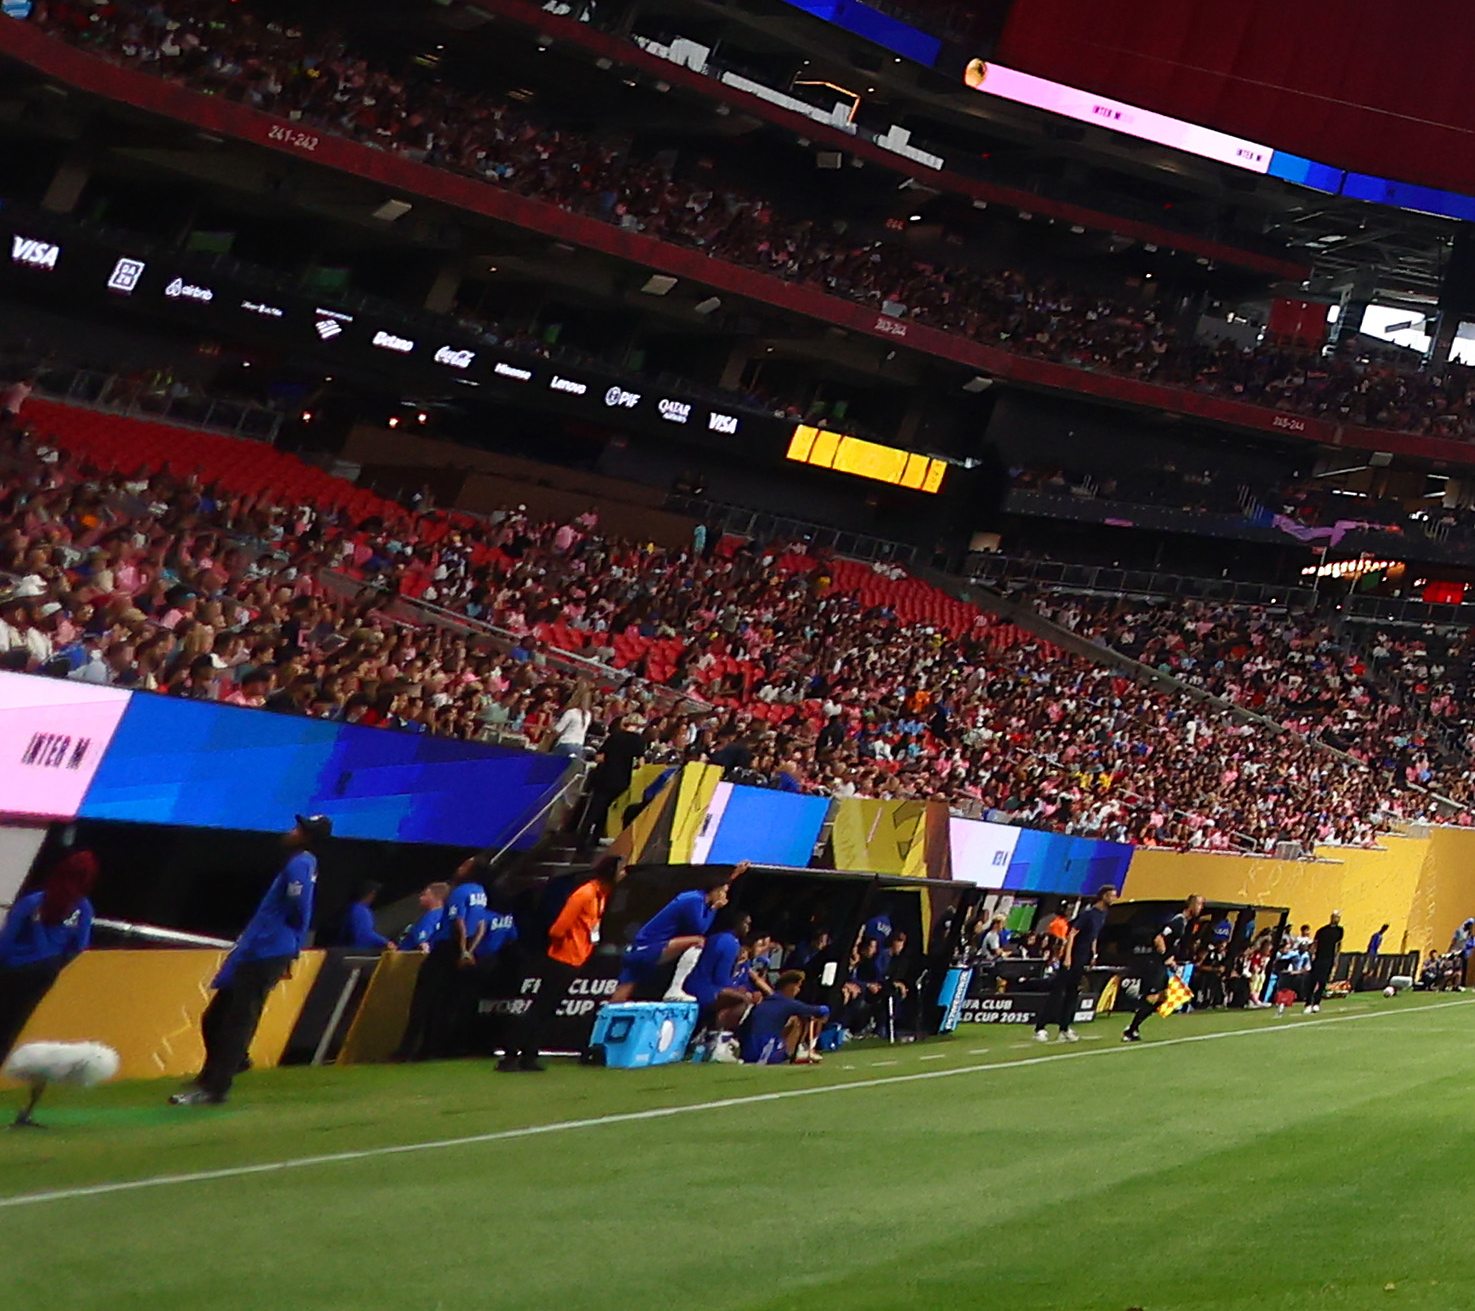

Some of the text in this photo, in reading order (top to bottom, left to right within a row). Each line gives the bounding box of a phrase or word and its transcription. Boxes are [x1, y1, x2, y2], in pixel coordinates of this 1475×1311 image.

[12, 235, 59, 268] VISA
[550, 375, 587, 394] Lenovo
[617, 391, 641, 408] PIF
[658, 399, 691, 417] QATAR
[709, 412, 738, 434] VISA
[21, 732, 71, 769] INTER
[980, 998, 1013, 1011] CLUB
[979, 1012, 1001, 1024] CUP
